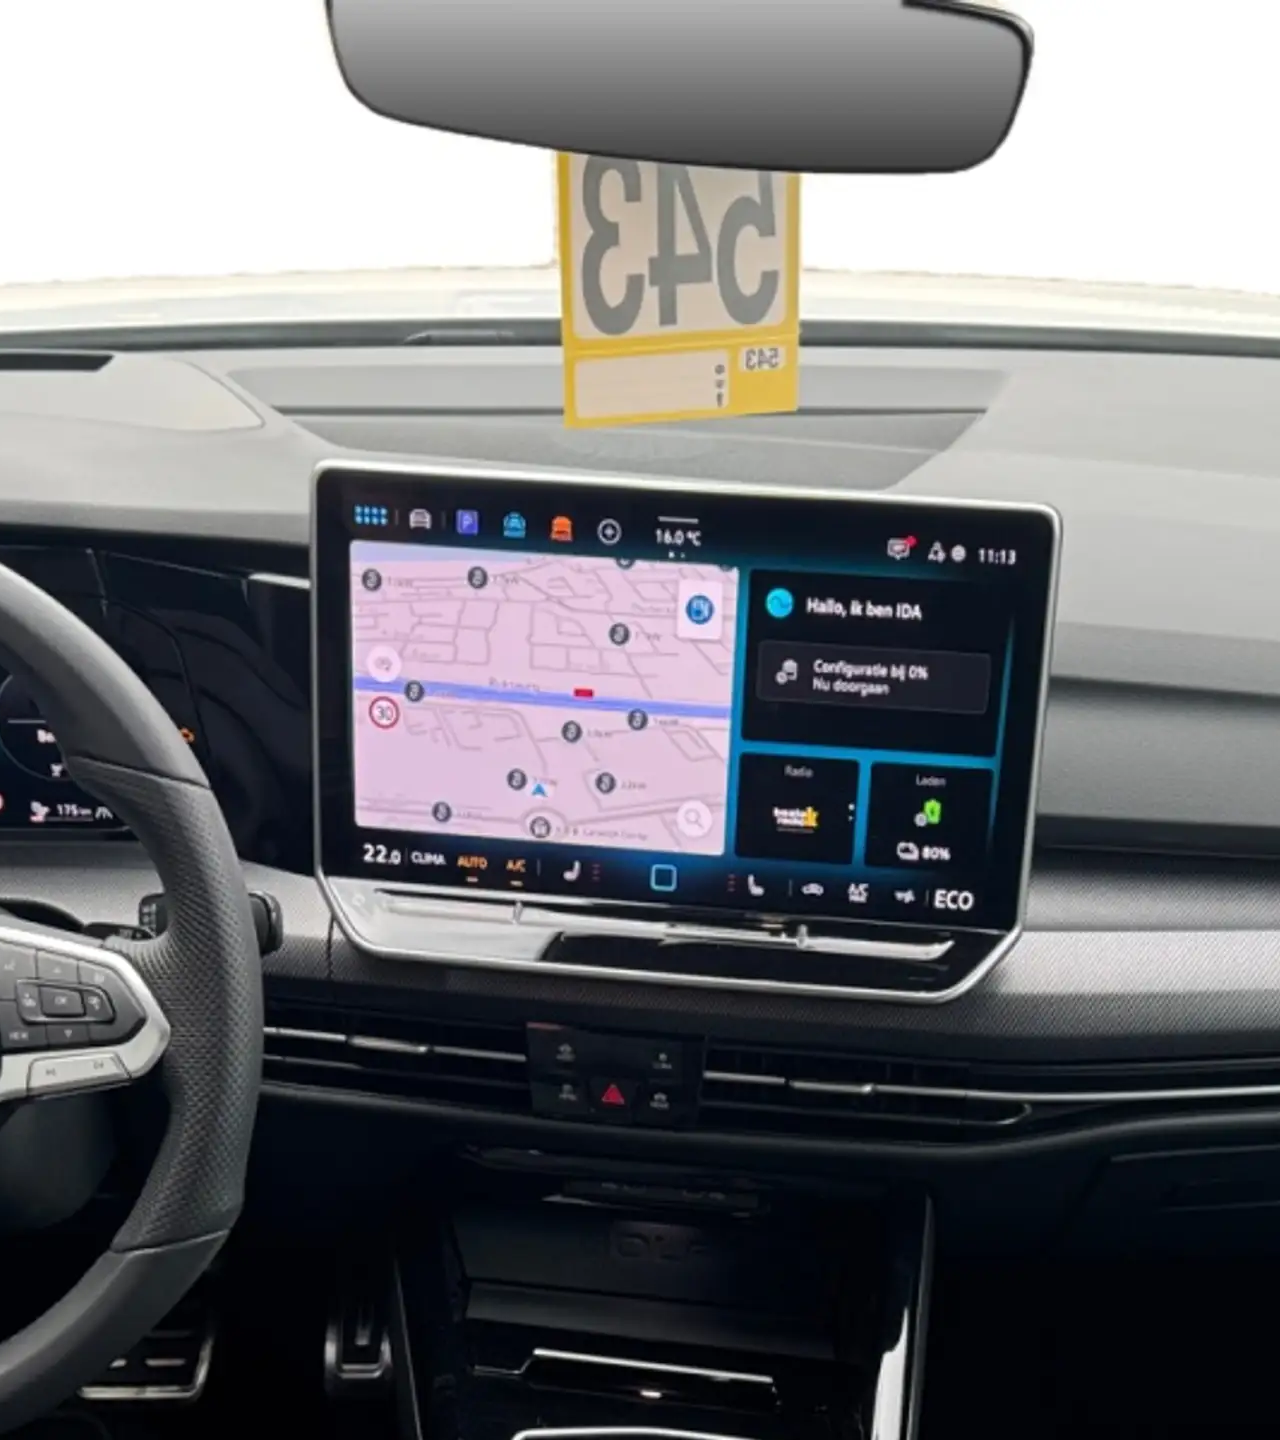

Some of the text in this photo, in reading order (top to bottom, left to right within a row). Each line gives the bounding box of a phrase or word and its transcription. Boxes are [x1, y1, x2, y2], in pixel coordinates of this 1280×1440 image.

[655, 529, 683, 546] 16.0
[978, 548, 1017, 565] 11:13
[806, 597, 847, 618] Hallo,
[866, 601, 893, 618] ben
[896, 602, 922, 620] IDA
[812, 659, 929, 682] Configuratie bij 0%
[812, 676, 890, 698] Nu doorgaan
[375, 704, 394, 723] 30
[784, 764, 814, 779] Radio
[915, 773, 946, 788] Laden
[363, 843, 401, 866] 22.0
[411, 851, 447, 866] CLIMA
[457, 854, 488, 870] AUTO
[921, 846, 951, 861] 80%
[506, 858, 526, 873] A/C
[934, 889, 974, 911] ECO
